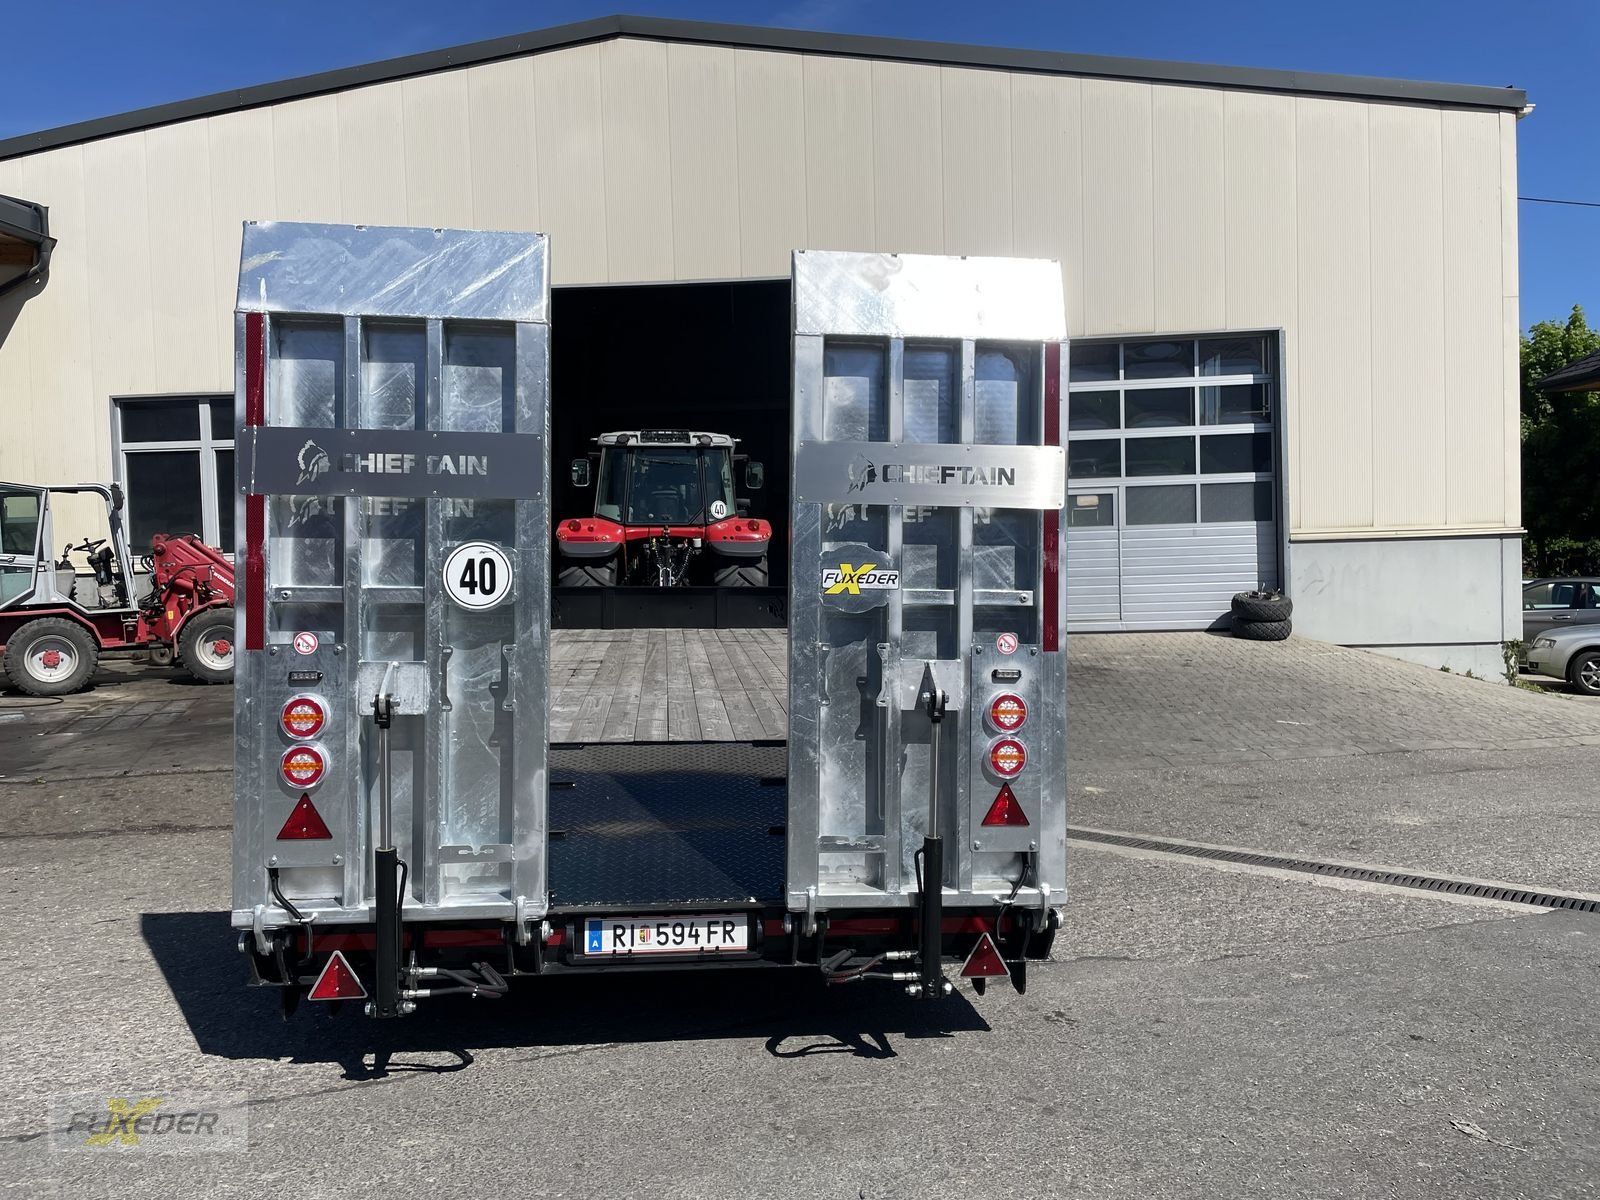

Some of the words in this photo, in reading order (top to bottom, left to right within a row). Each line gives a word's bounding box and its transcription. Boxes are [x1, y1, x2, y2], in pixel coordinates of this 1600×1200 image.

[882, 464, 1016, 486] CHIEFTAIN
[715, 504, 725, 515] 40
[459, 557, 496, 596] 40
[823, 570, 899, 588] FLIXEDER
[592, 940, 599, 948] A
[612, 924, 635, 947] RI
[656, 922, 700, 946] 594
[707, 920, 736, 944] FR
